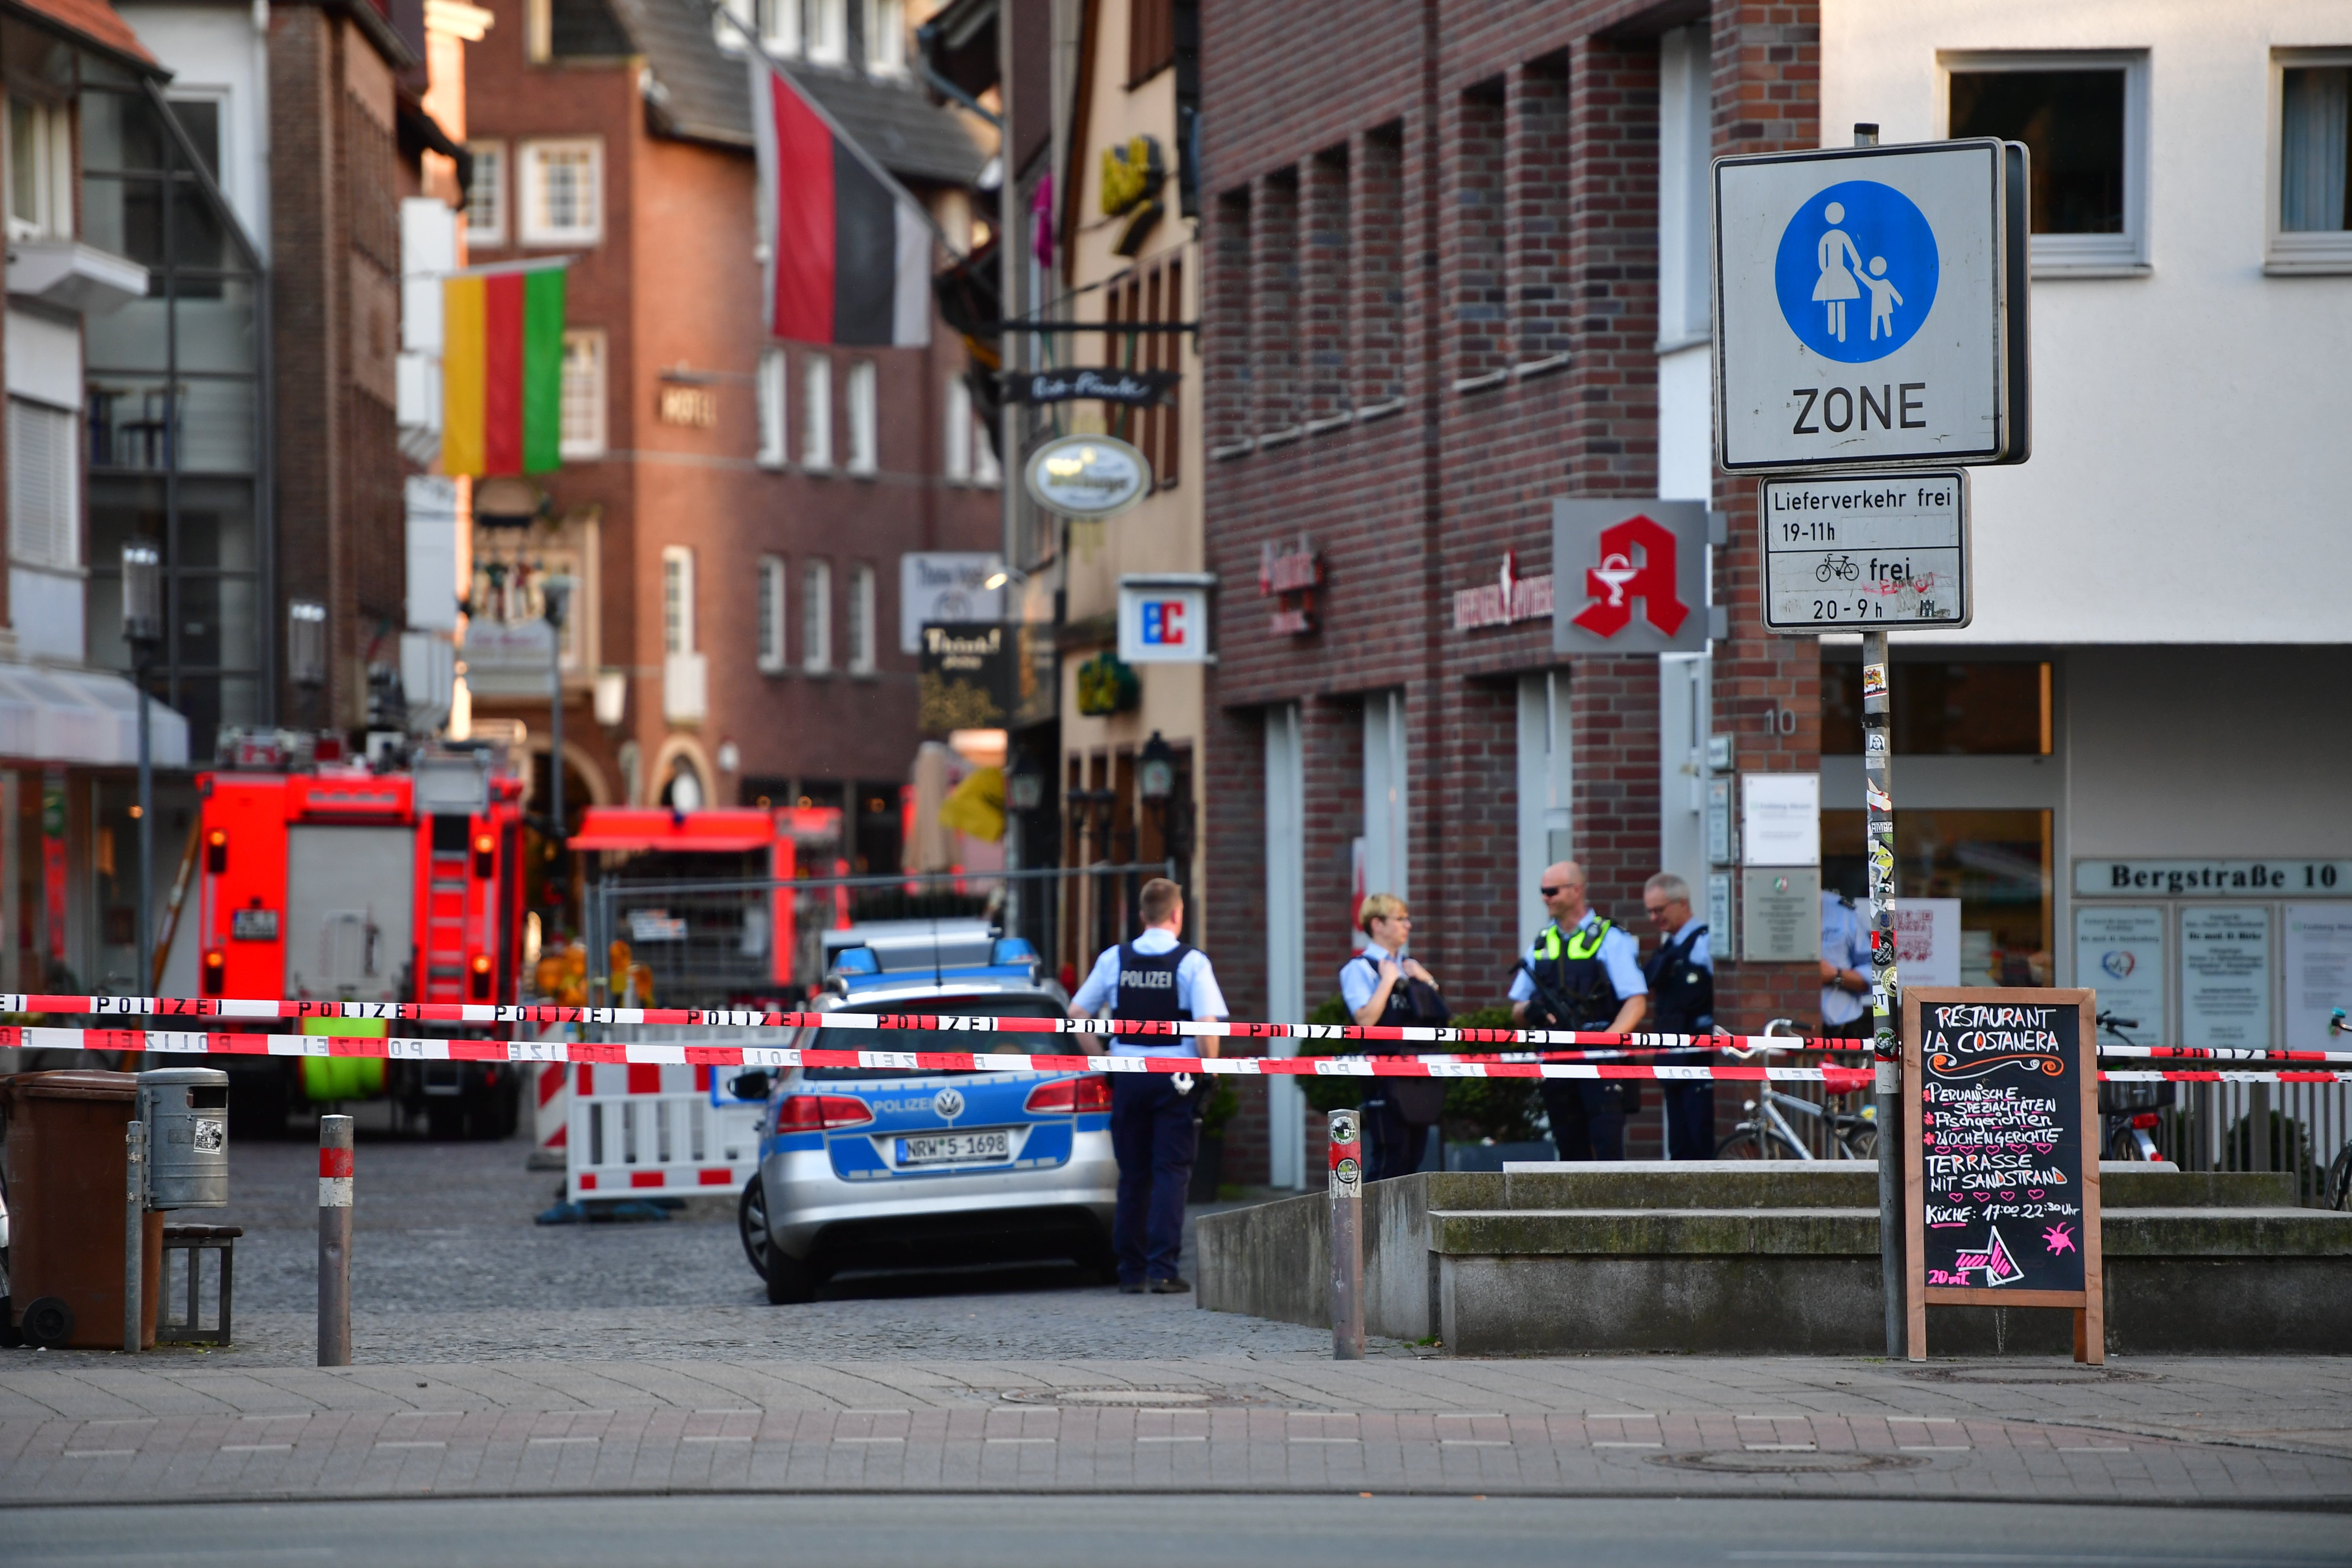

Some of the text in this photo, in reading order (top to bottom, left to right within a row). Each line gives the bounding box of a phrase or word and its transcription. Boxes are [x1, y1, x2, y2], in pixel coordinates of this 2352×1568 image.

[1792, 382, 1926, 435] ZONE
[1774, 487, 1951, 511] Lieferverkehr frei
[1783, 522, 1835, 542] 19-11h
[1870, 557, 1910, 581] frei
[1765, 709, 1796, 735] 10
[2111, 864, 2337, 893] Bergstraße 10
[1120, 970, 1172, 988] POLIZEI
[97, 996, 222, 1015] POLIZEI
[298, 1002, 422, 1019] POLIZEI
[495, 1005, 615, 1024] POLIZEI
[687, 1010, 805, 1027] POLIZEI
[877, 1014, 995, 1032] POLIZEI
[1064, 1018, 1181, 1035] POLIZEI
[1250, 1024, 1365, 1039] POLIZEI
[1935, 1004, 2057, 1029] RESTAURANT
[1923, 1030, 1949, 1053] LA
[1957, 1029, 2059, 1054] COSTANERA
[873, 1098, 934, 1114] POLIZEI
[907, 1140, 936, 1158] NRW
[1925, 1154, 2032, 1176] TERRASSE
[1961, 1167, 2068, 1190] SANDSTRAND
[2061, 1203, 2080, 1216] Uhr
